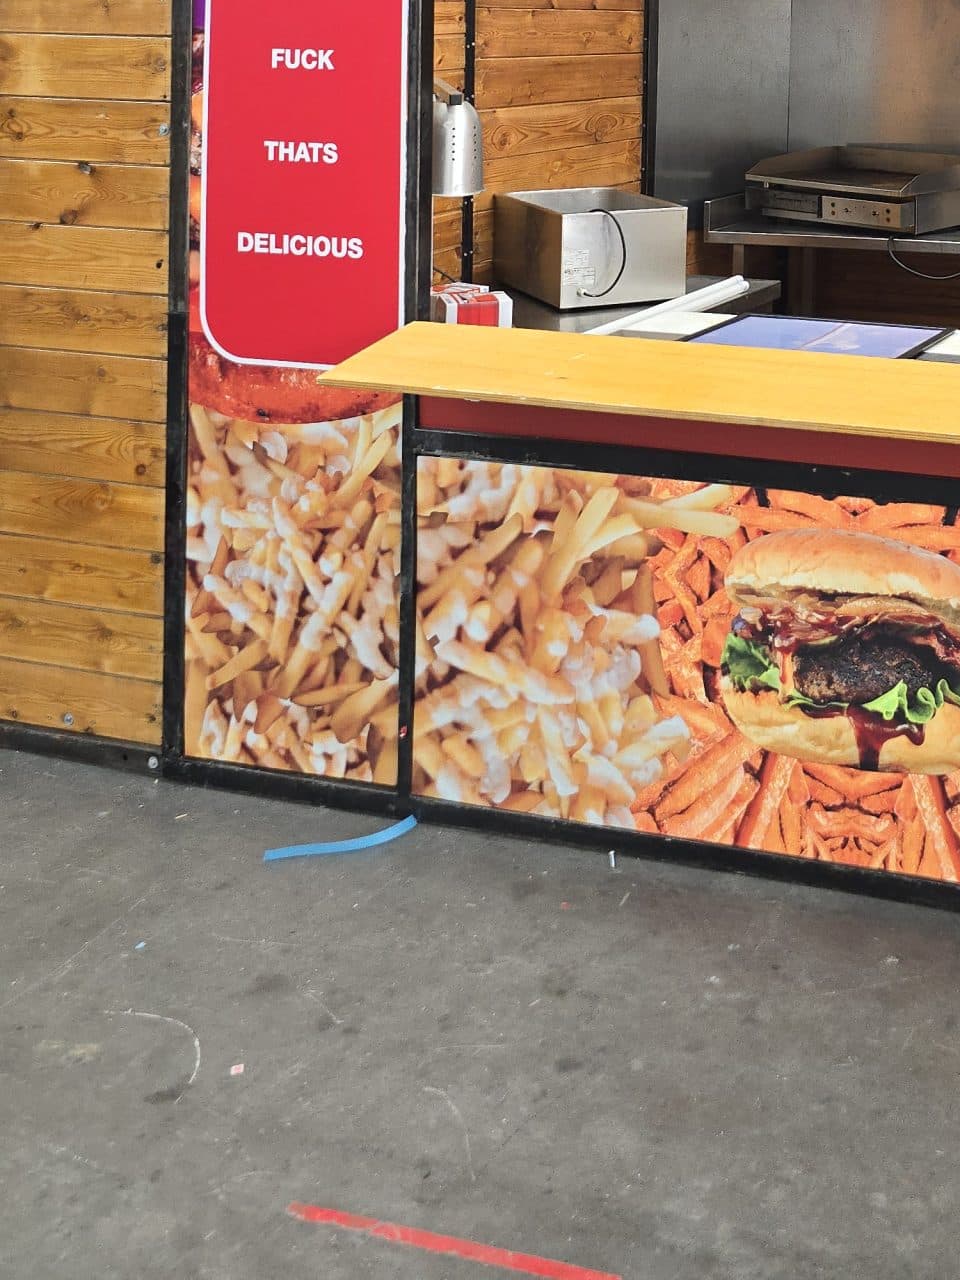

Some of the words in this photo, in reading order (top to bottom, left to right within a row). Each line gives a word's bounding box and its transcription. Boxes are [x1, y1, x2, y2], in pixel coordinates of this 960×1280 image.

[270, 48, 335, 71] FUCK
[263, 140, 339, 163] THATS
[237, 231, 364, 260] DELICIOUS
